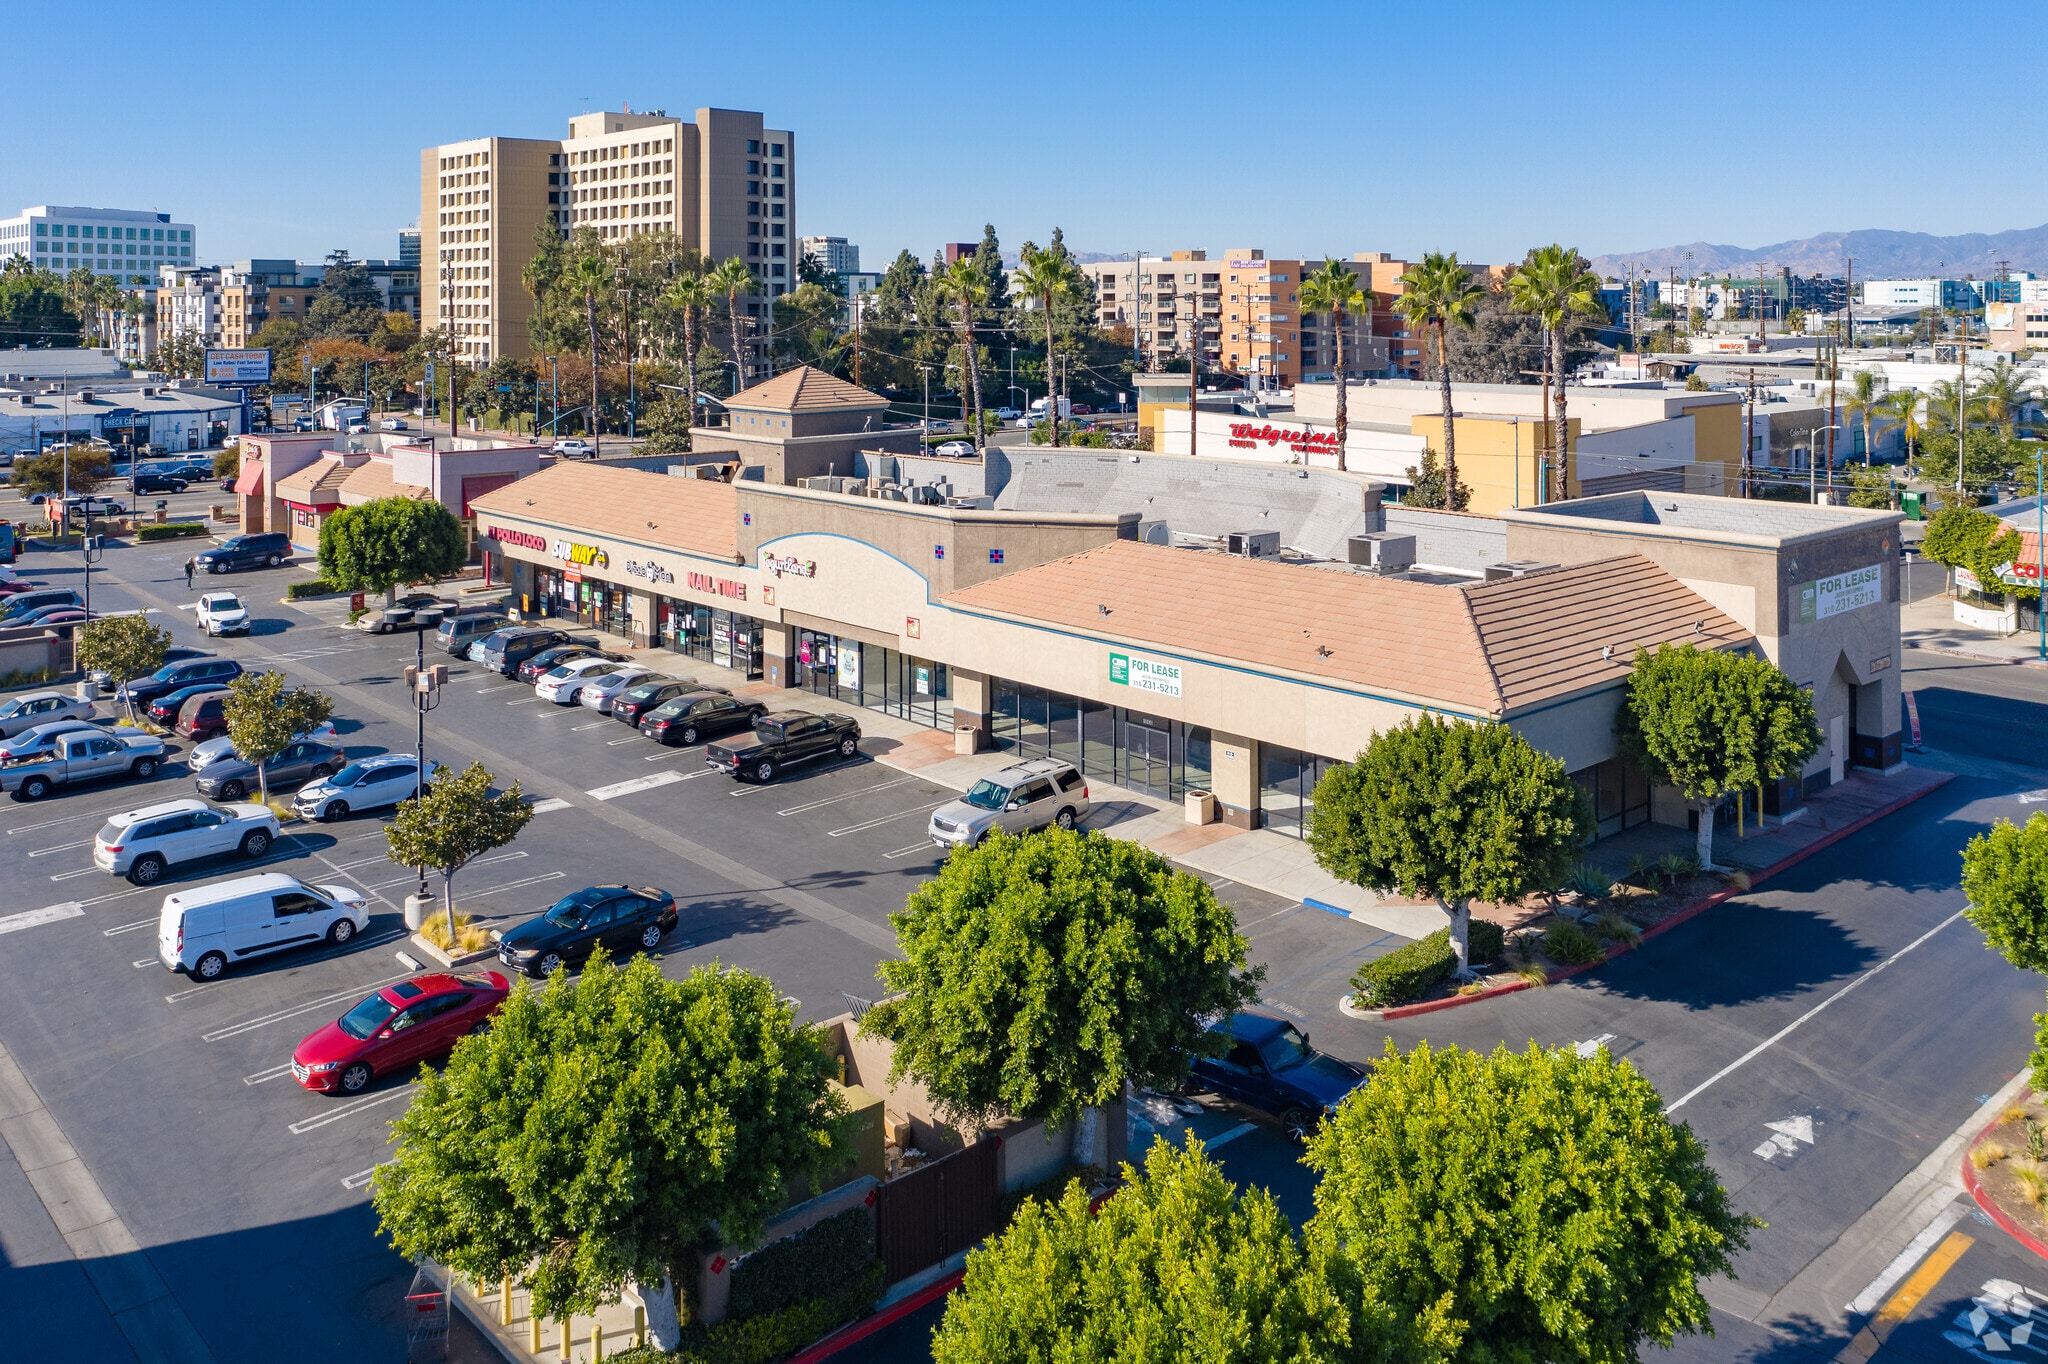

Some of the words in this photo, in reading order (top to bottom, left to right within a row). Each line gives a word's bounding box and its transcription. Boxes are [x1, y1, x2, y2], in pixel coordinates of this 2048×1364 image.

[210, 352, 224, 360] GET
[226, 352, 244, 360] CASH
[245, 352, 266, 360] TODAY
[103, 418, 123, 427] CHECK
[1228, 423, 1339, 446] Walgreens
[1228, 439, 1257, 449] PHOTO
[1290, 444, 1339, 455] PHARMACY
[497, 529, 522, 545] POLLO
[522, 533, 546, 551] LOCO
[551, 539, 597, 565] SUBWAY
[687, 571, 715, 594] NAIL
[715, 577, 746, 601] TIME
[1819, 577, 1842, 595] FOR
[1844, 568, 1878, 588] LEASE
[1823, 605, 1835, 615] 310
[1835, 590, 1875, 612] 231-5213
[1132, 659, 1149, 673] FOR
[1151, 663, 1180, 679] LEASE
[1142, 679, 1179, 696] 231-5213
